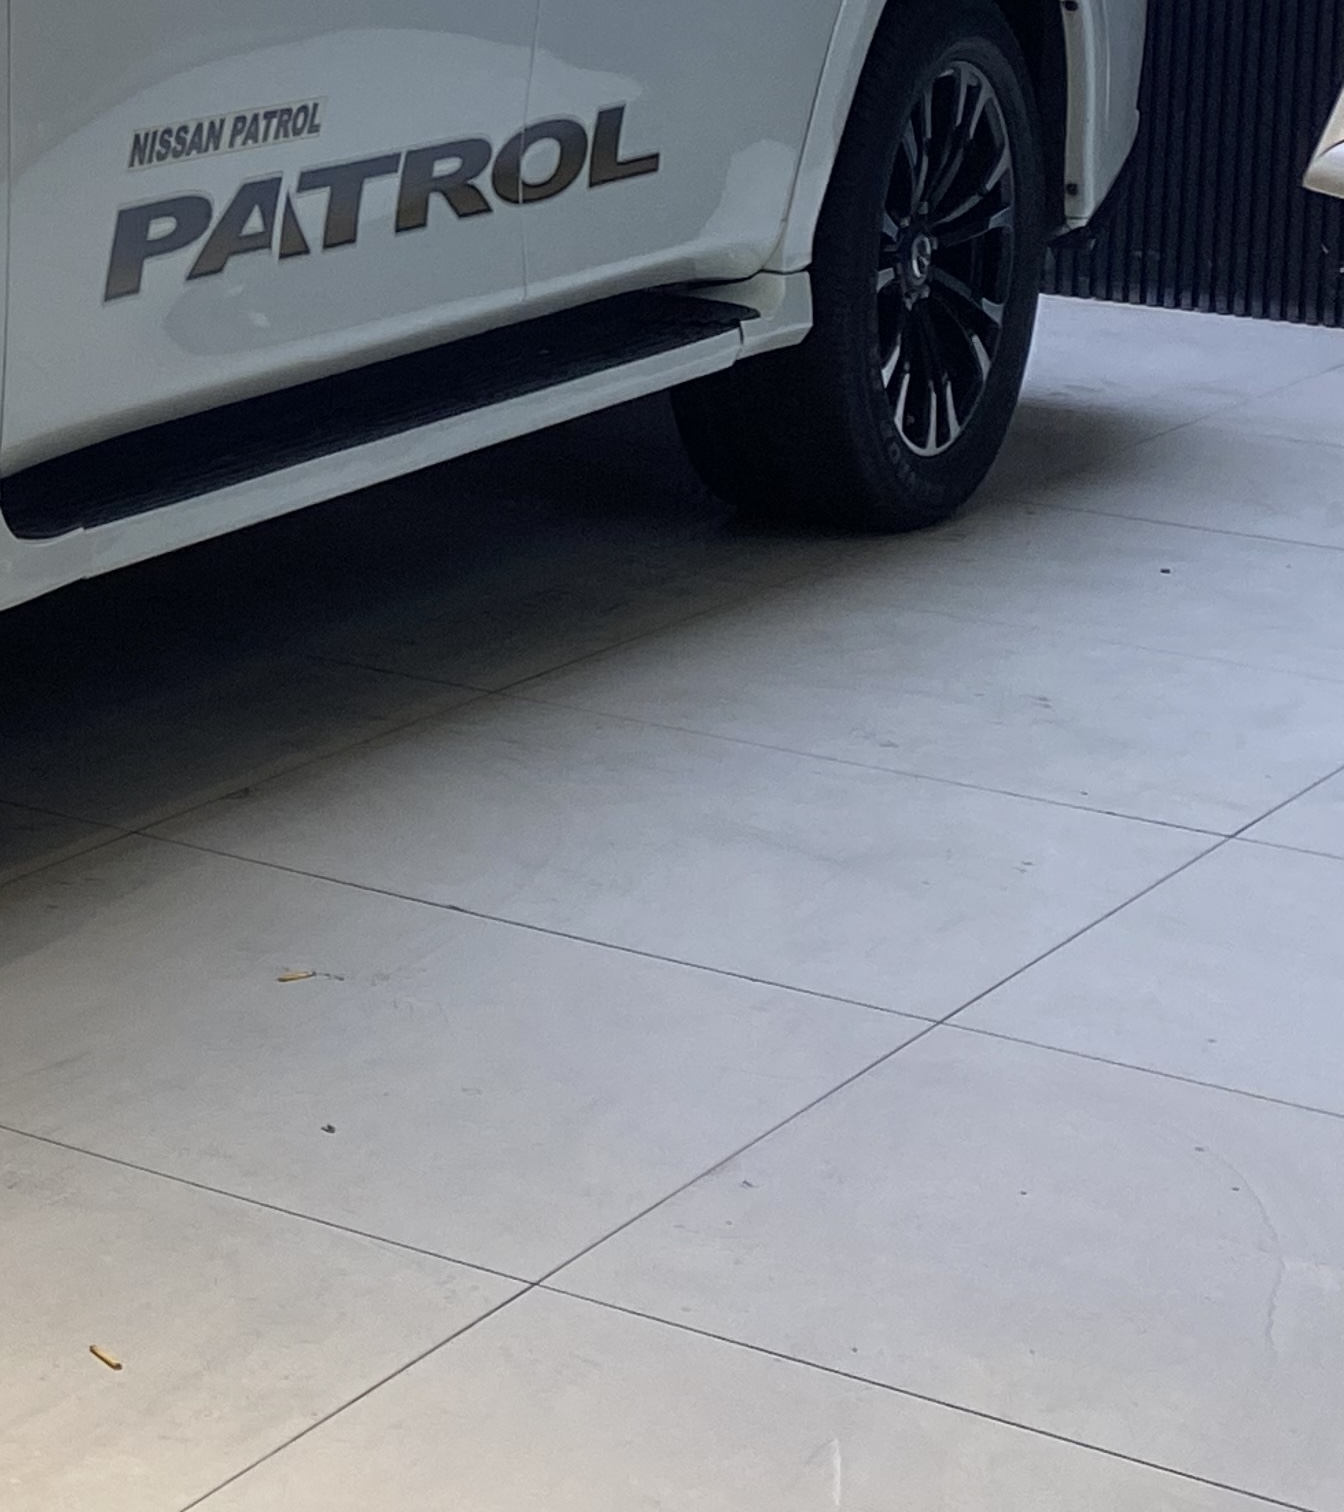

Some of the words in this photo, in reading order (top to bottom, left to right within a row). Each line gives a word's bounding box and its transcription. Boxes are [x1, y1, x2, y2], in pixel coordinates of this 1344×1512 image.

[127, 116, 226, 169] NISSAN
[227, 101, 322, 149] PATROL
[102, 104, 661, 304] PATROL
